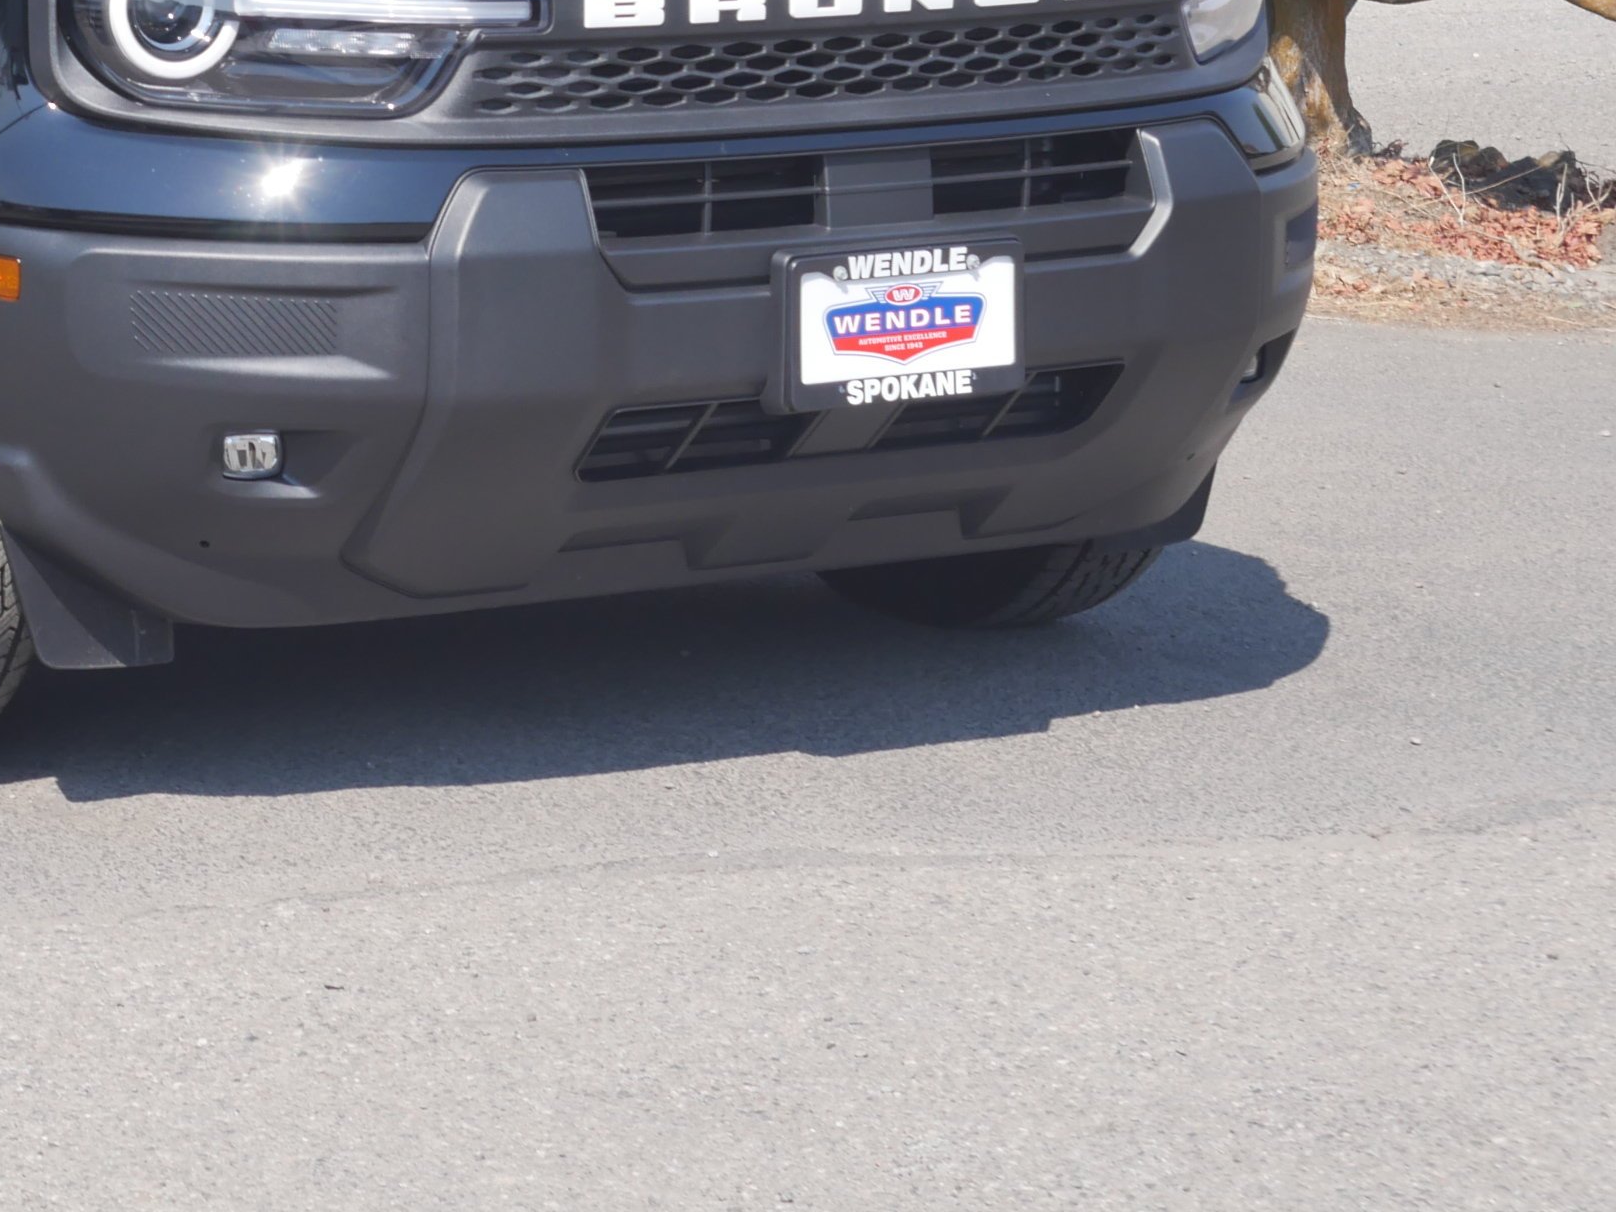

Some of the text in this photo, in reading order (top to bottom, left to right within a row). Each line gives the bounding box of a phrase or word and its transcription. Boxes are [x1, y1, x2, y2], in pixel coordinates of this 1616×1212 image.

[848, 246, 968, 280] WENDLE
[834, 304, 972, 334] WENDLE
[858, 331, 947, 346] AUTOMOTIVE EXCELLENCE
[884, 342, 905, 351] SINCE
[846, 369, 973, 406] SPOKANE
